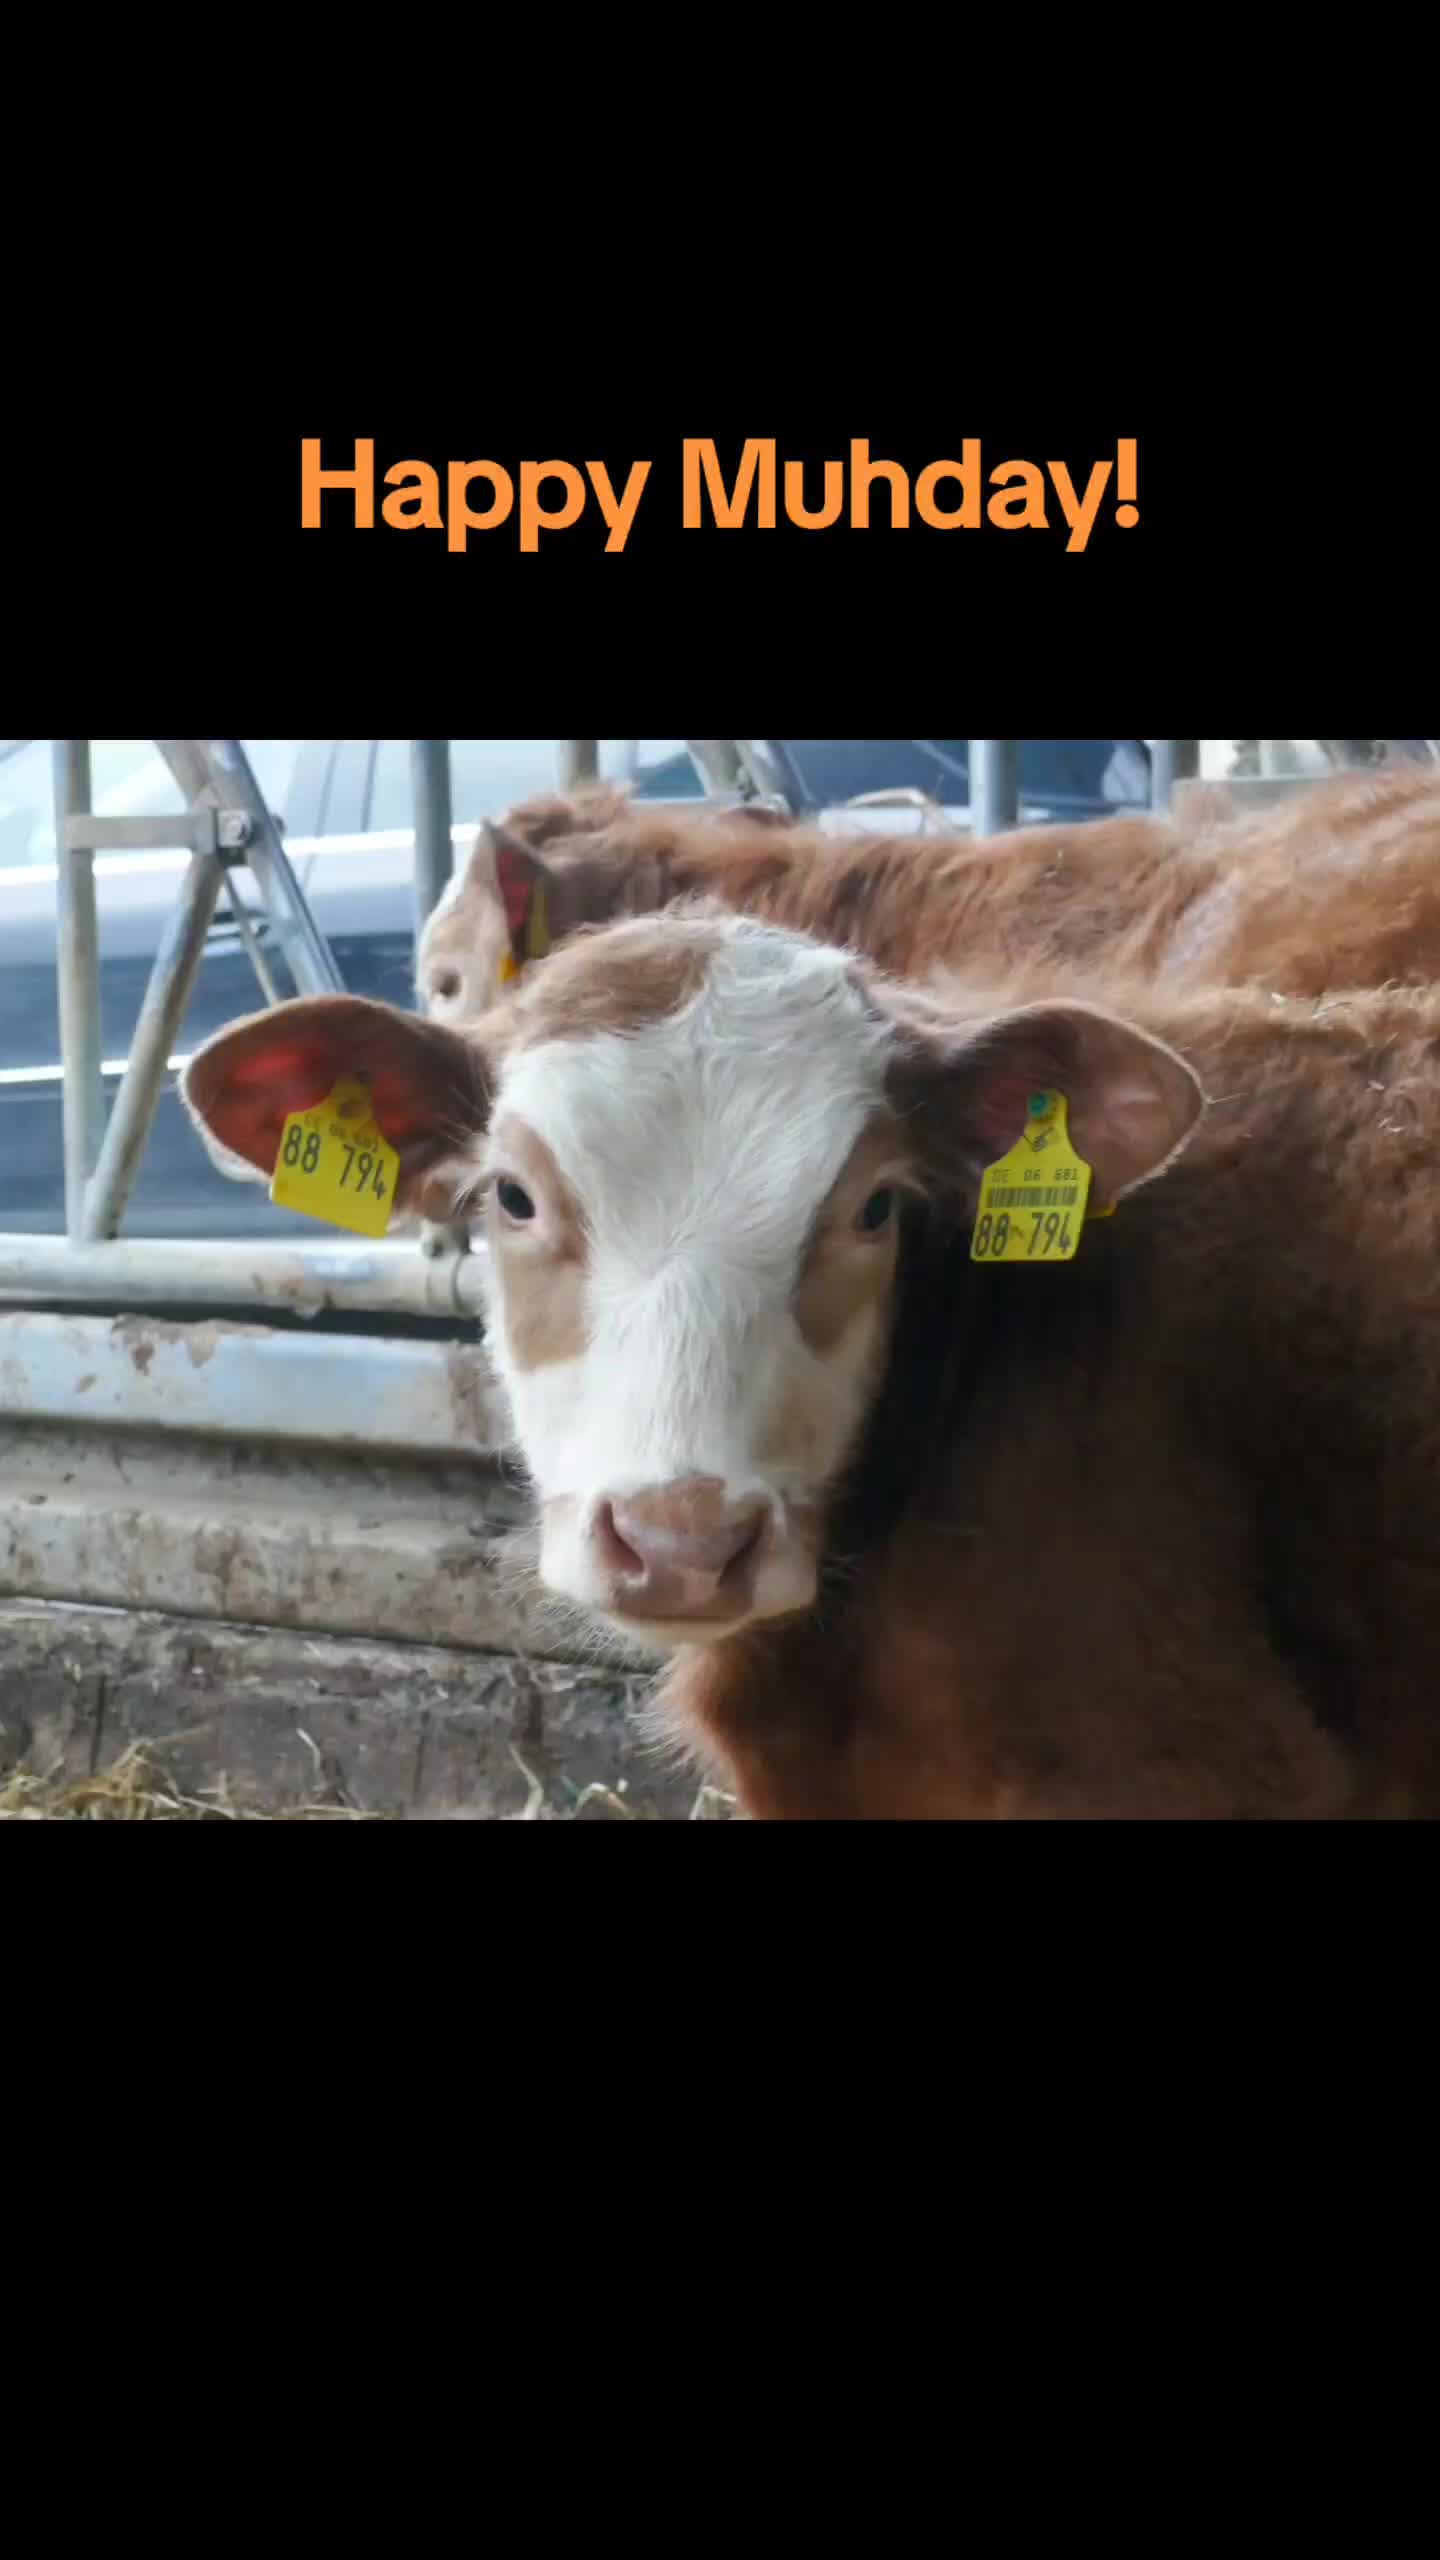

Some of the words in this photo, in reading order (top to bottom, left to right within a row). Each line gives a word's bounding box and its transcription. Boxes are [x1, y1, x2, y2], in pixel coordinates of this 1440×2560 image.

[283, 1124, 321, 1174] 88
[340, 1143, 387, 1201] 794
[975, 1212, 1010, 1257] 88
[1027, 1211, 1073, 1255] 794
